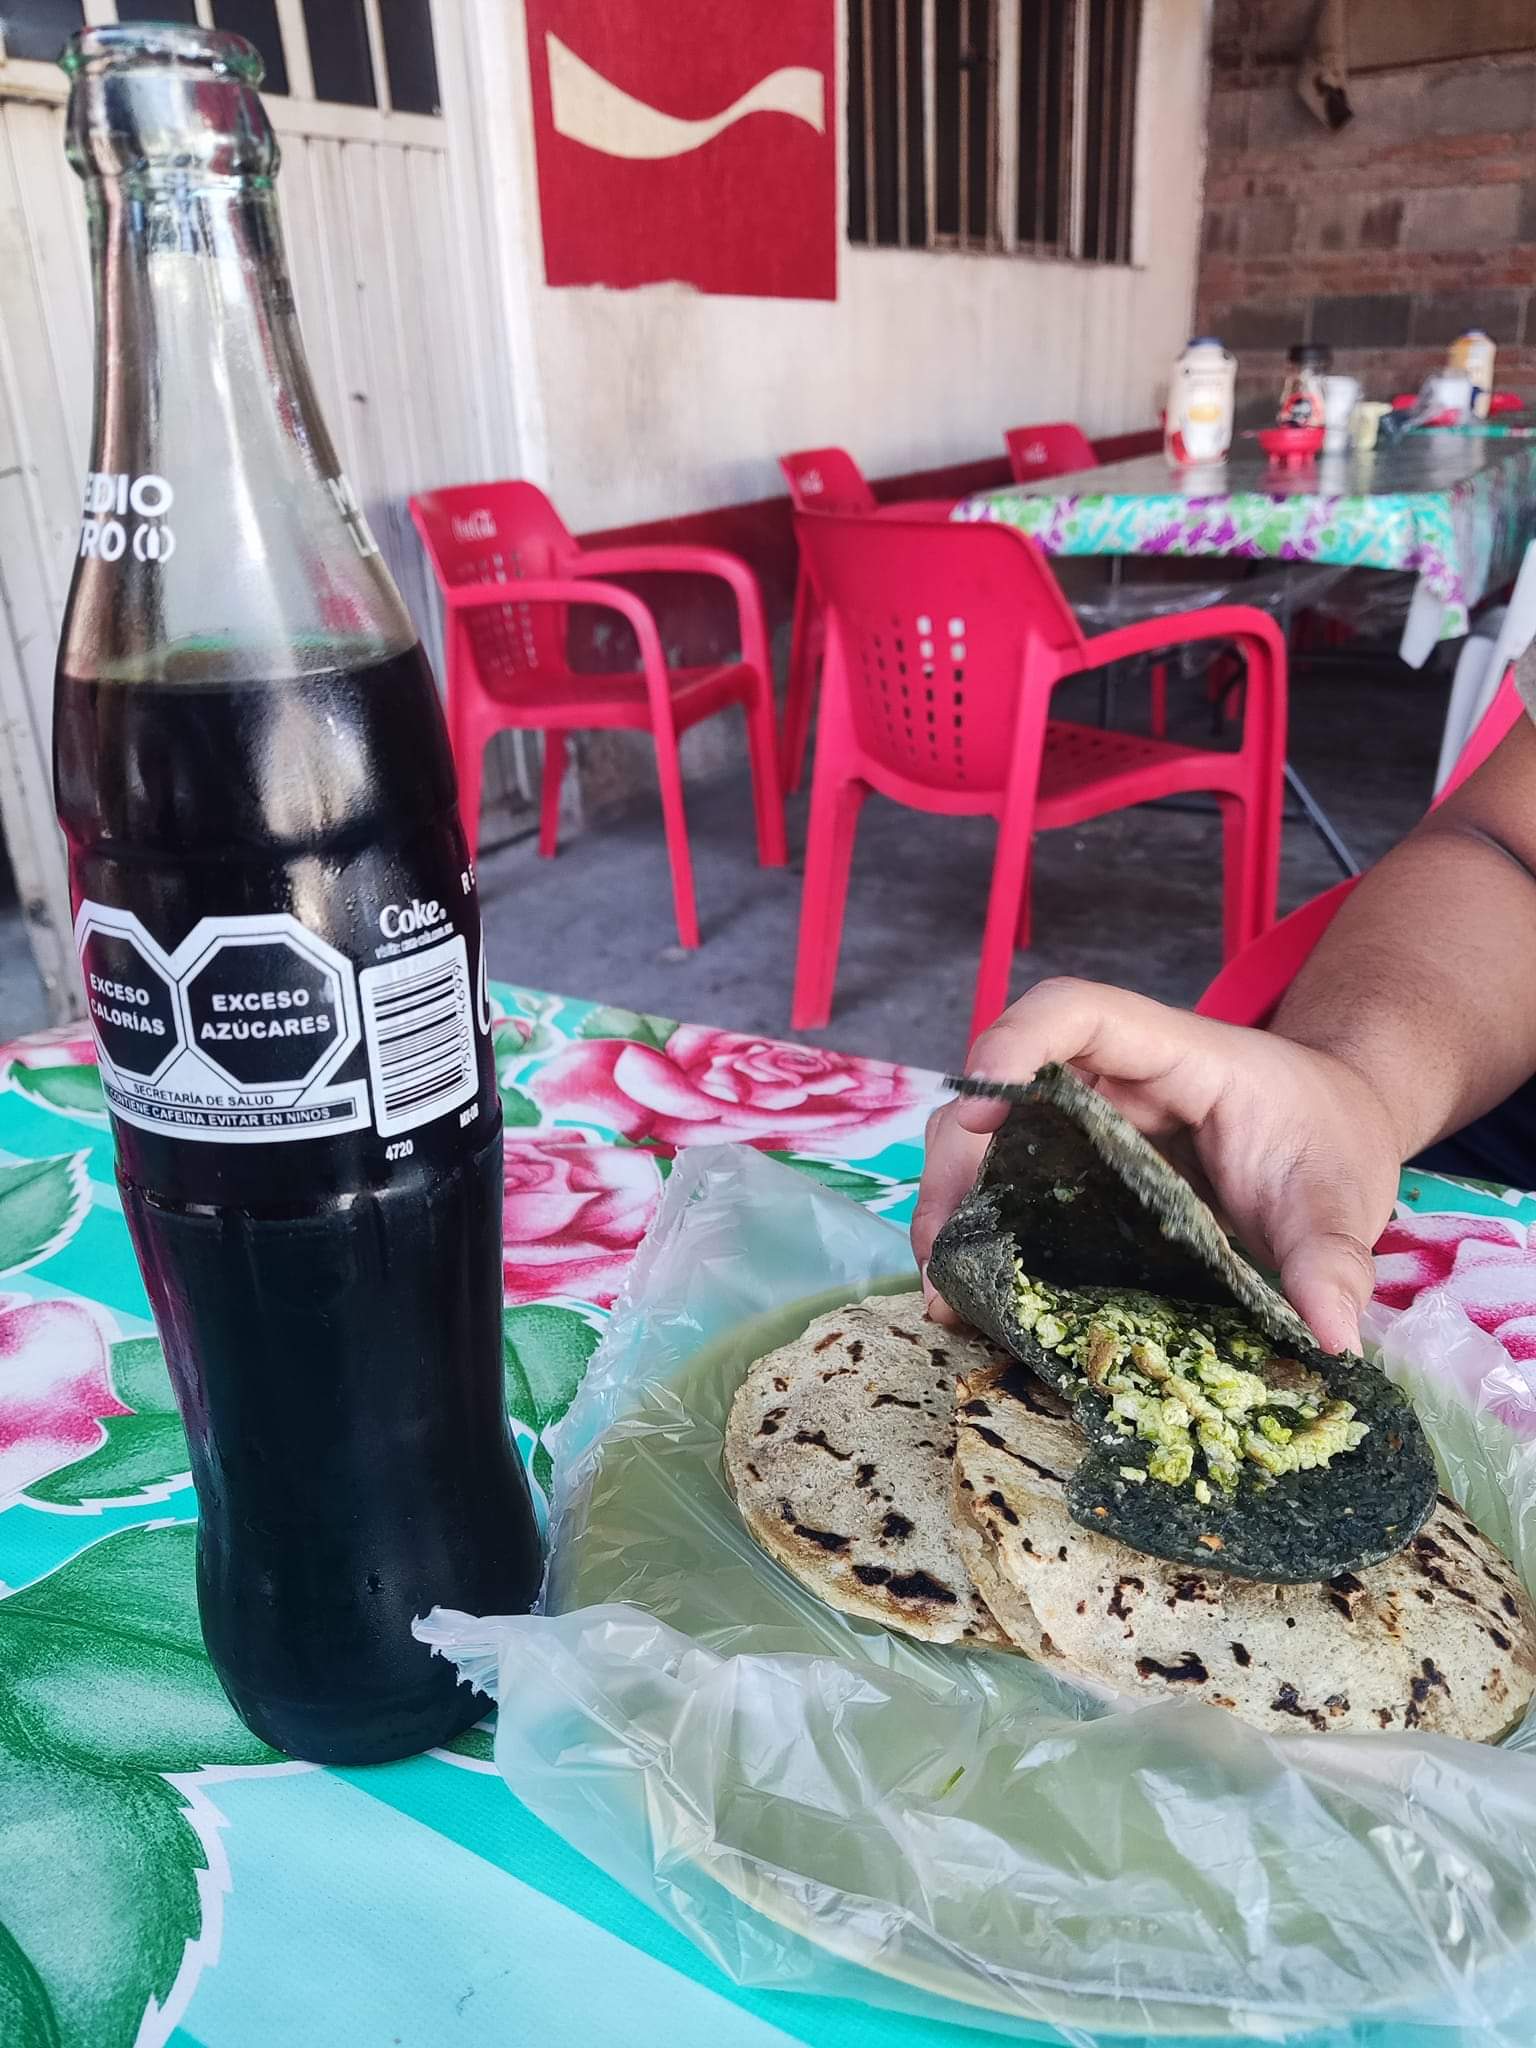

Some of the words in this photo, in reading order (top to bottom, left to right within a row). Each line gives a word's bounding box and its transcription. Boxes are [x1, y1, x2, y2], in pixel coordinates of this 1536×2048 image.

[90, 973, 150, 1006] EXCESO
[212, 988, 310, 1012] EXCESO
[91, 998, 165, 1036] CALORÍAS
[200, 1014, 331, 1040] AZÚCARES
[134, 1083, 203, 1105] SECRETARÍA
[206, 1095, 224, 1107] DE
[228, 1095, 274, 1106] SALUD
[208, 1114, 261, 1127] EVITAR
[263, 1112, 283, 1125] EN
[385, 1139, 414, 1161] 4720
